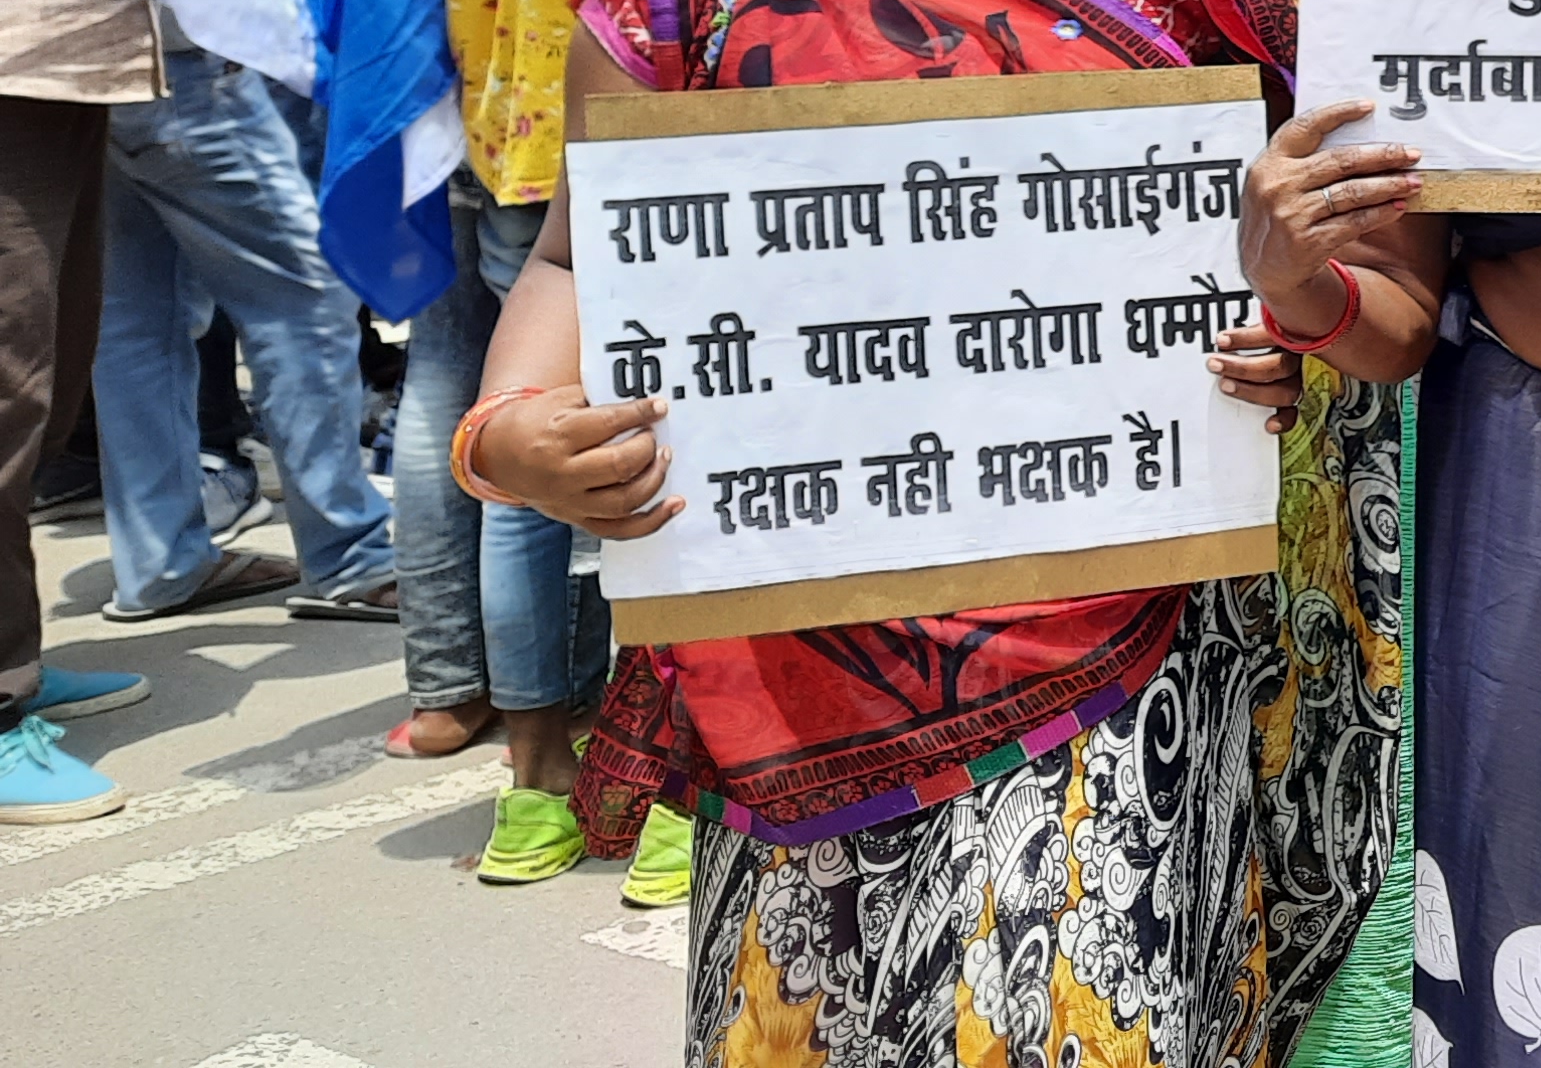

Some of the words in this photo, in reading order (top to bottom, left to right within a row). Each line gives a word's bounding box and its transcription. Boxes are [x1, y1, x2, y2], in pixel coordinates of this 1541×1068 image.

[603, 193, 729, 263] राणा
[750, 183, 885, 257] प्रताप
[902, 157, 999, 243] सिंह
[1017, 141, 1241, 235] गोसाईगंज
[798, 317, 930, 385] यादव
[949, 289, 1102, 373] दारोगा
[708, 460, 842, 534] रक्षक
[861, 432, 954, 517] नही
[978, 435, 1112, 506] भक्षक
[1122, 411, 1180, 491] है।
